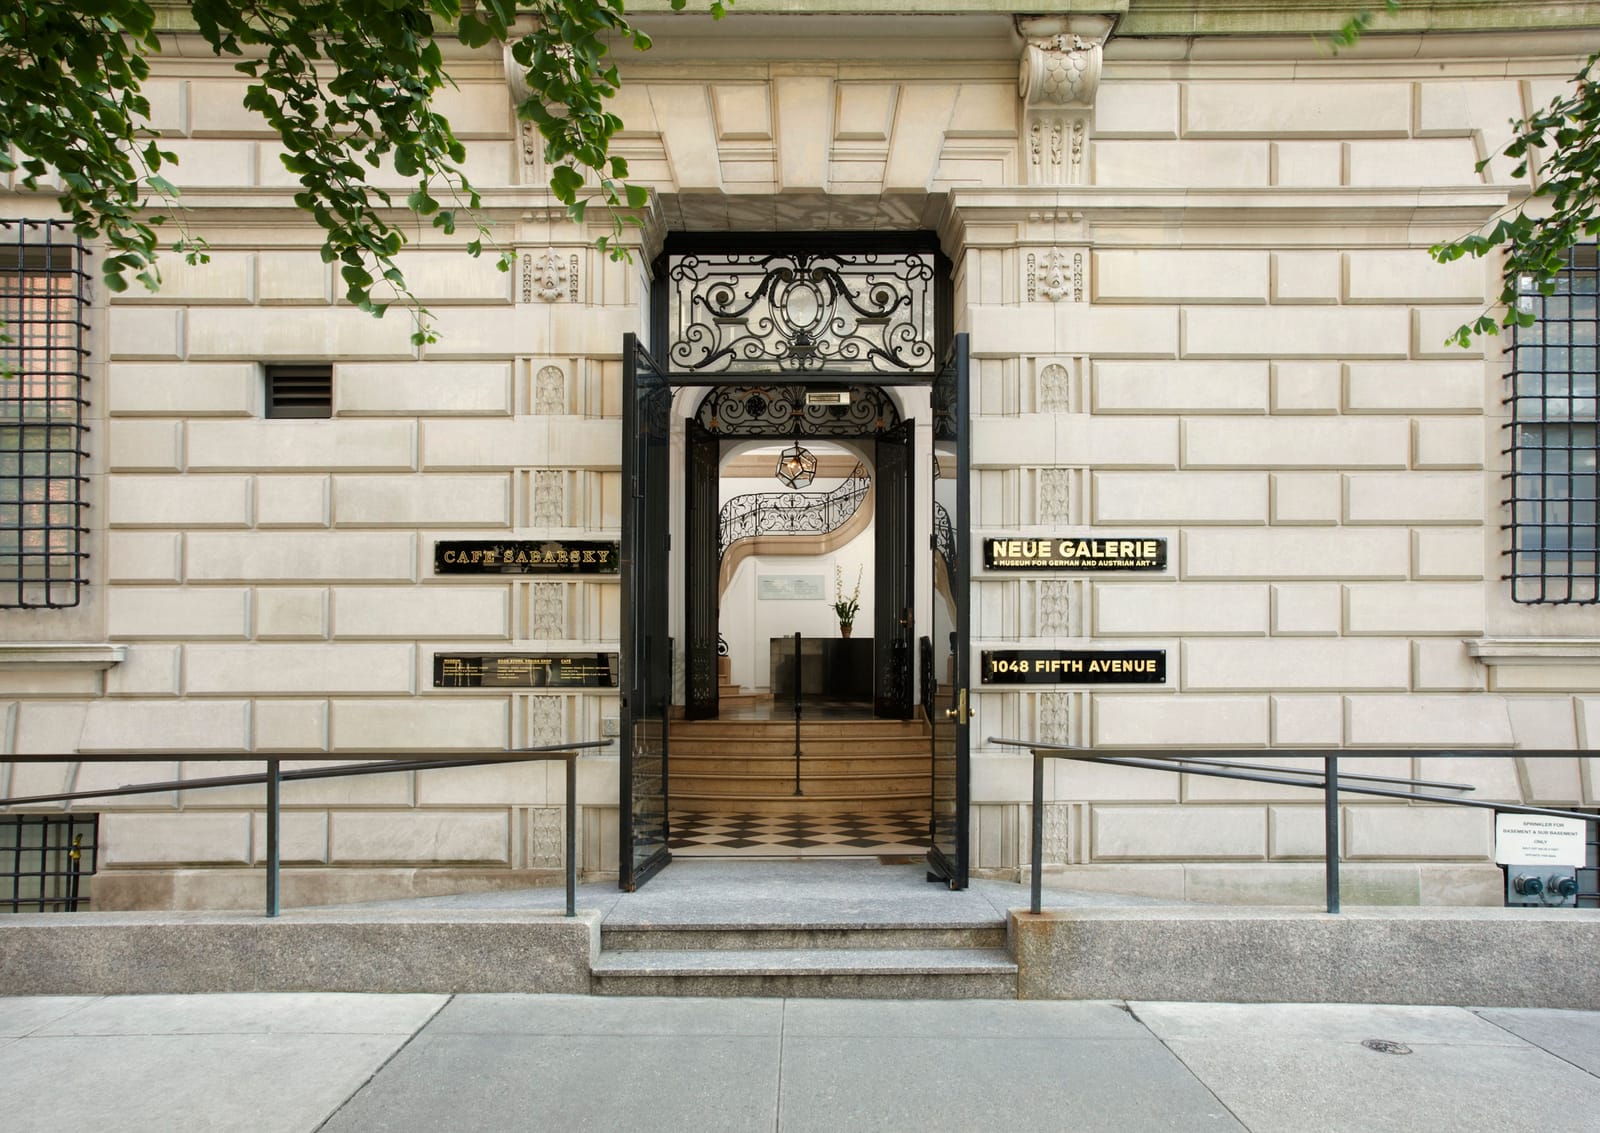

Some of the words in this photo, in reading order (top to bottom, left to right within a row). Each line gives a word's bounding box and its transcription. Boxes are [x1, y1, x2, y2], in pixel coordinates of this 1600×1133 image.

[993, 541, 1051, 557] NEUE
[1059, 541, 1157, 558] GALERIE
[503, 550, 610, 563] SABARSKY
[992, 660, 1029, 673] 1048
[1035, 660, 1083, 673] FIFTH
[1088, 660, 1157, 673] AVENUE
